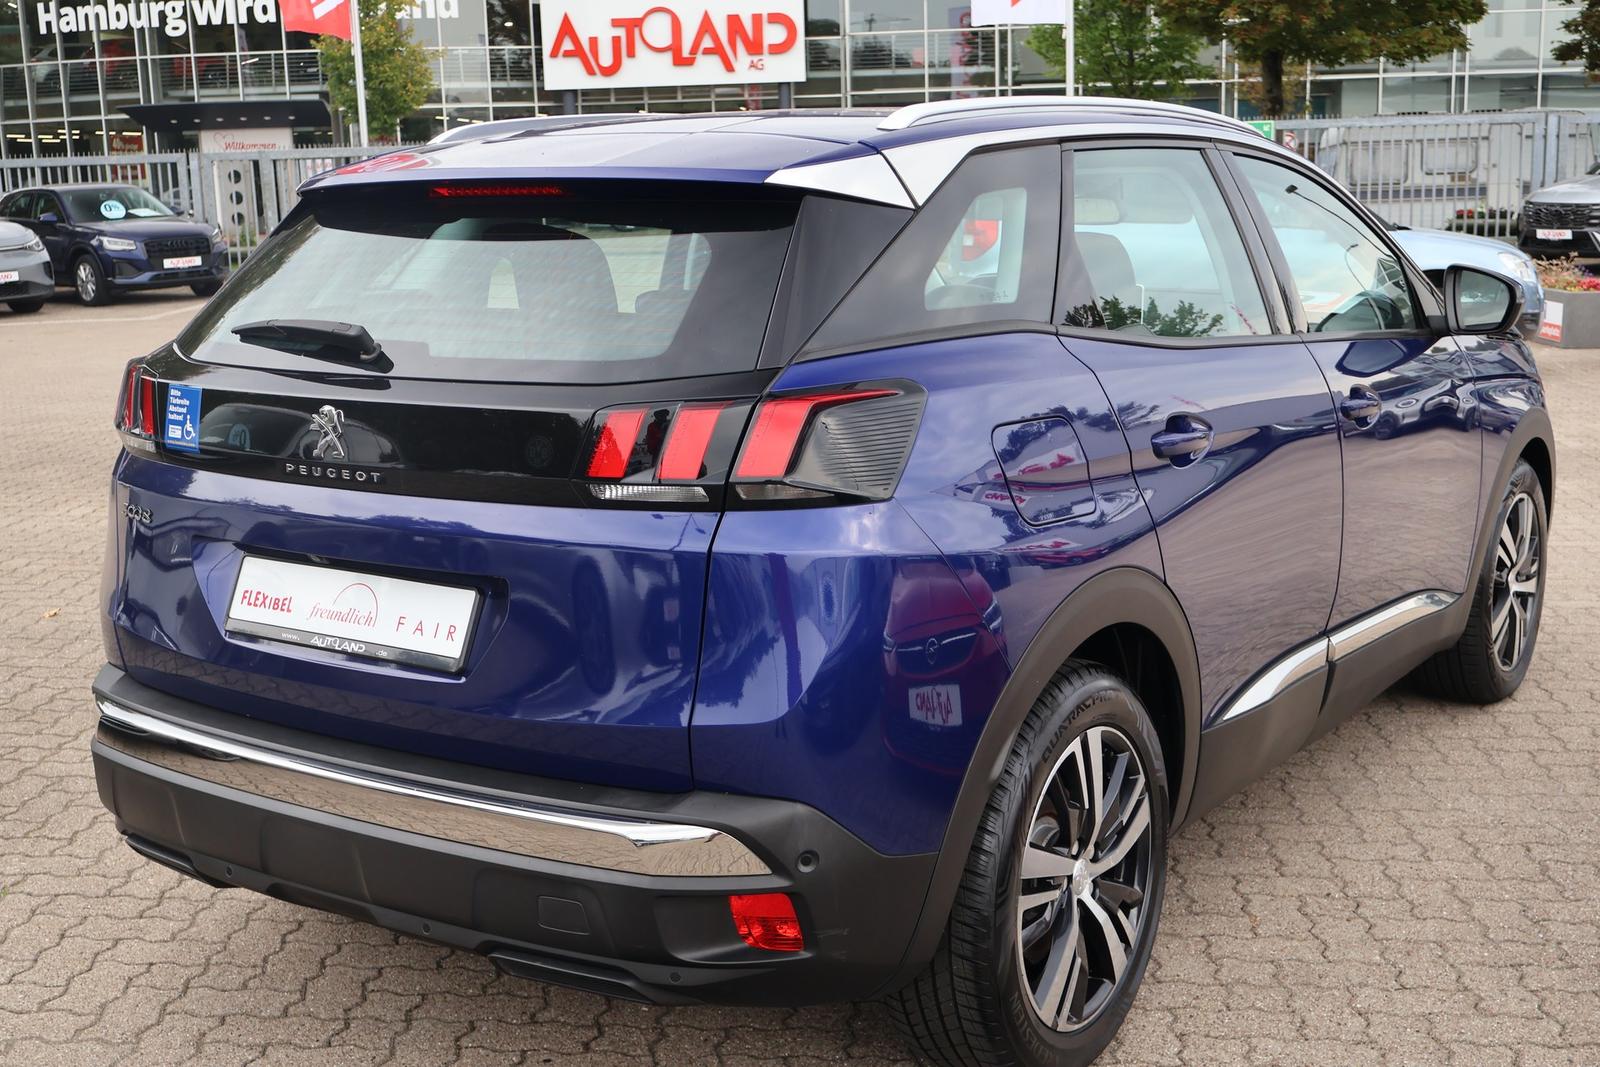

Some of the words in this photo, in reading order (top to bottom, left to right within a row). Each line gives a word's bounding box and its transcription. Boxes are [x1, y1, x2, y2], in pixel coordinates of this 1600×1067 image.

[36, 0, 188, 37] Hamburg
[190, 0, 277, 27] wird
[550, 7, 798, 77] AUTOLAND
[748, 59, 765, 71] AG
[224, 141, 277, 151] Willkommen
[285, 463, 381, 483] PEUGEOT
[240, 590, 293, 614] FLEXIBEL
[306, 602, 376, 628] freundlich
[396, 616, 457, 642] FAIR
[281, 631, 300, 641] www.
[310, 635, 366, 653] AUTOLAND
